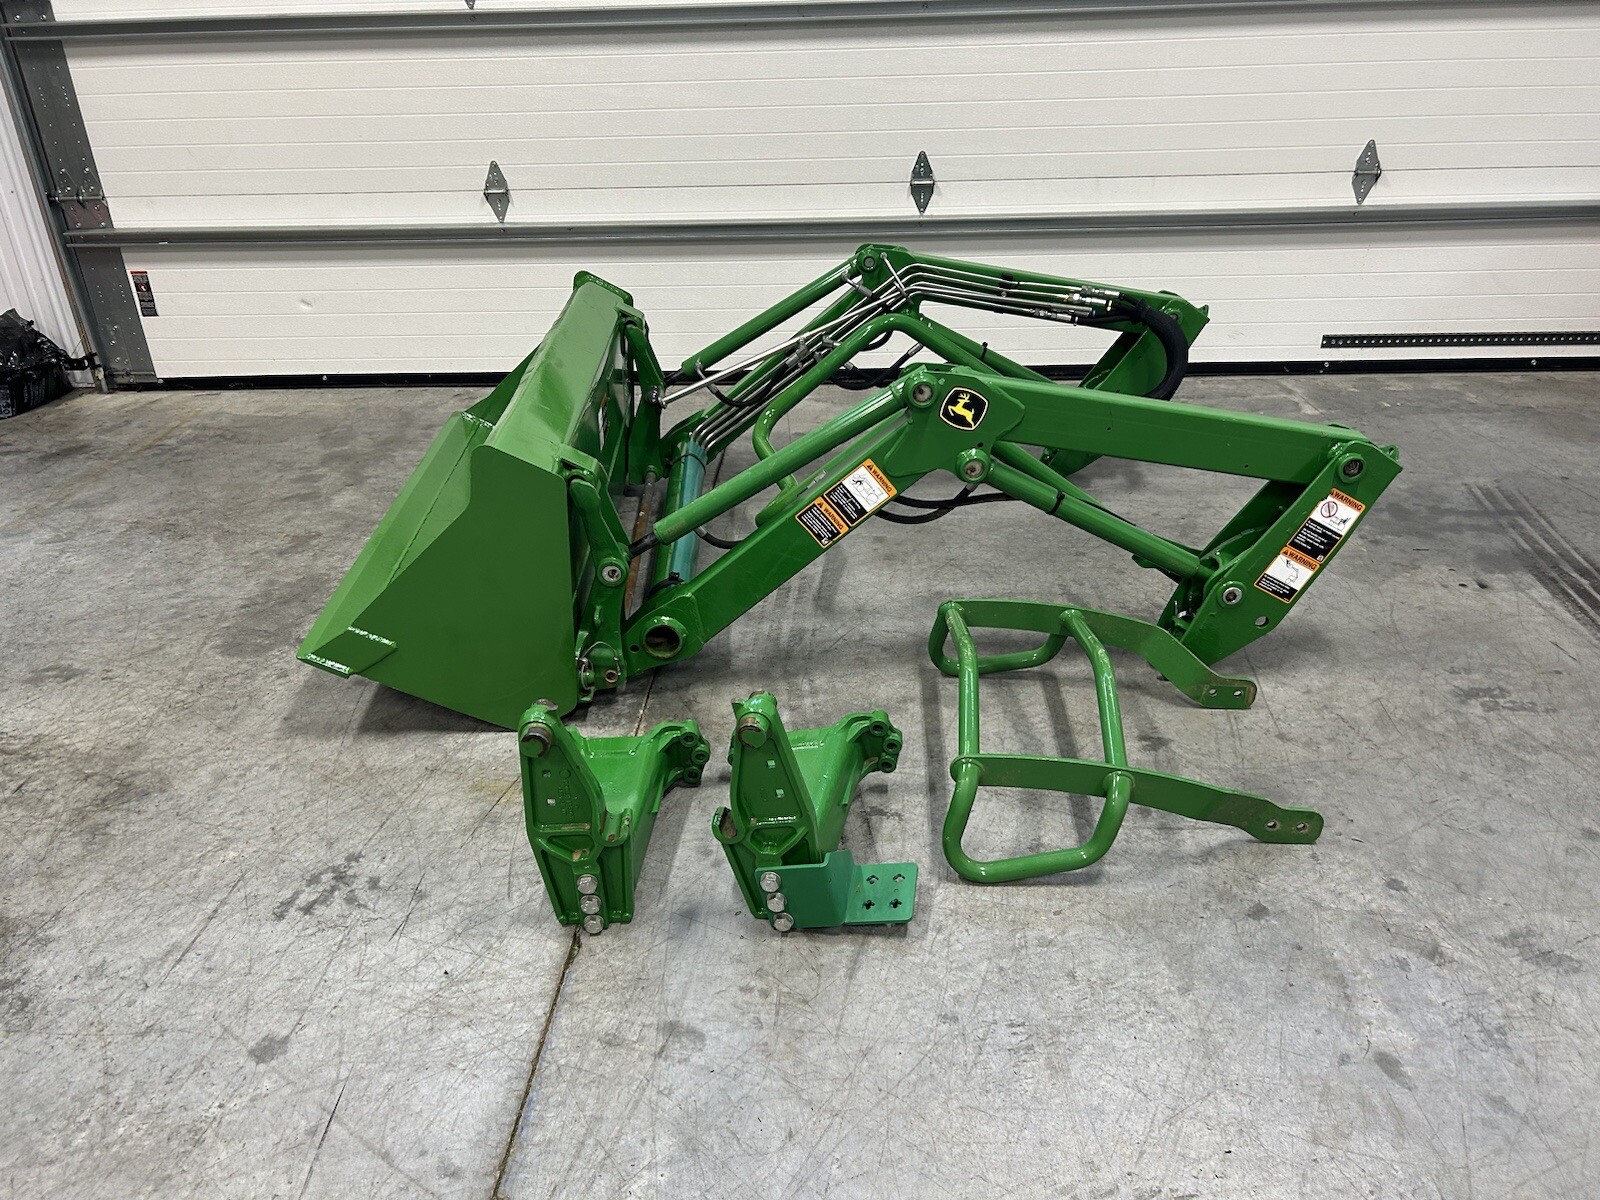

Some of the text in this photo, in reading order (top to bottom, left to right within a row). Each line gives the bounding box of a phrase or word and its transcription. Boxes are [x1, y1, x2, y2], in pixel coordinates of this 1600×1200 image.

[870, 468, 892, 493] WARNING
[1333, 489, 1363, 511] WARNING
[823, 507, 844, 530] WARNING
[1288, 550, 1317, 571] WARNING
